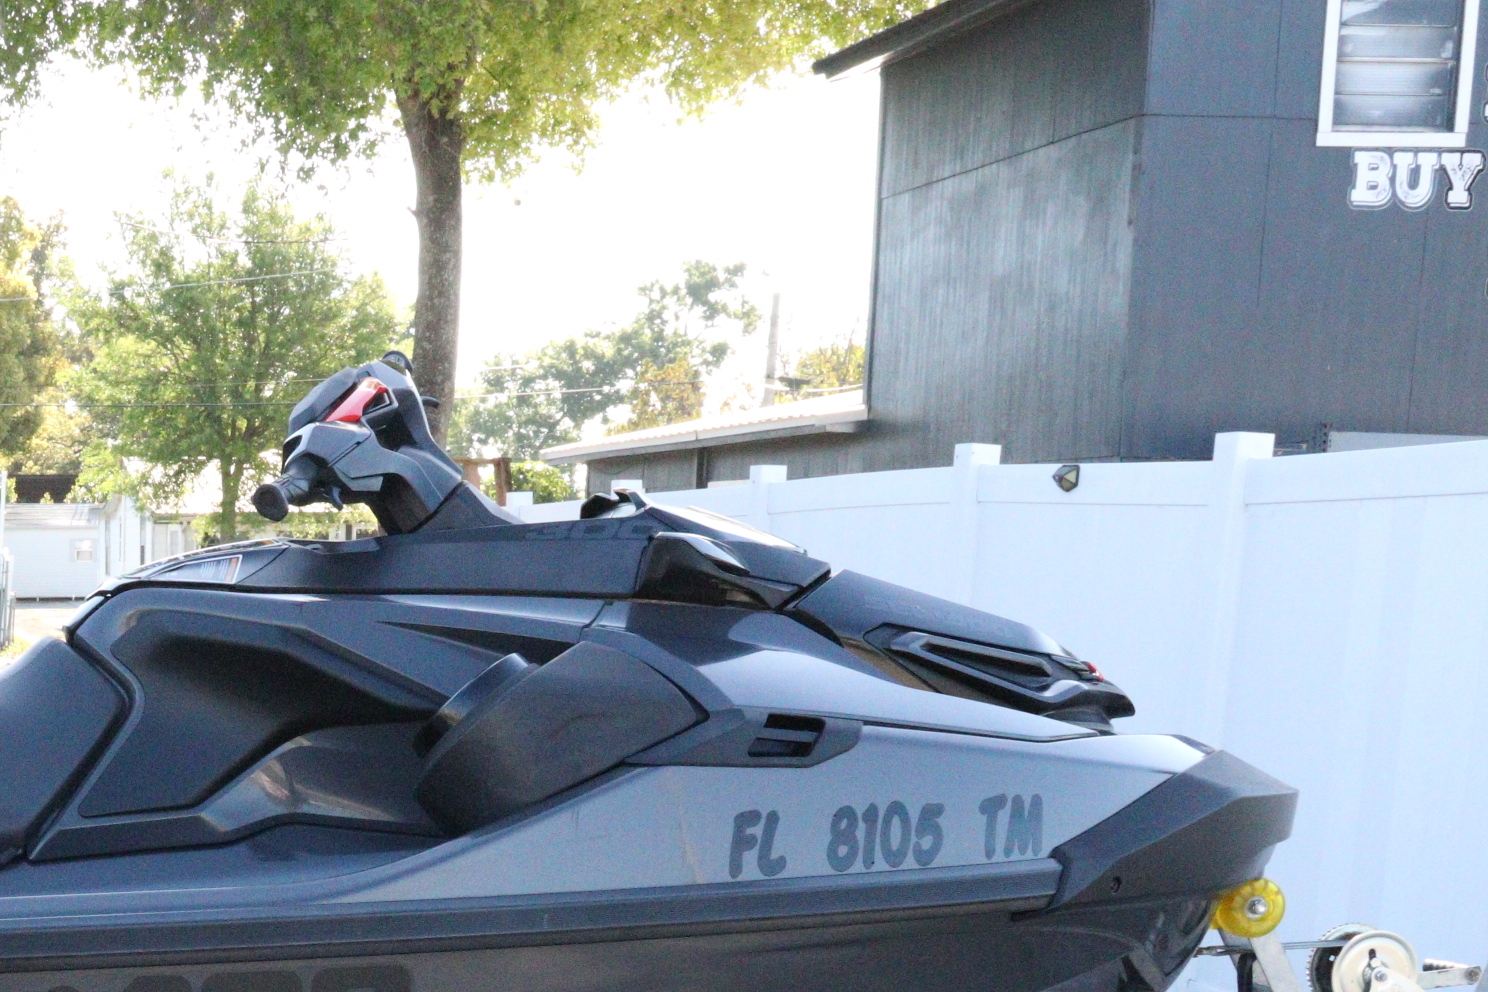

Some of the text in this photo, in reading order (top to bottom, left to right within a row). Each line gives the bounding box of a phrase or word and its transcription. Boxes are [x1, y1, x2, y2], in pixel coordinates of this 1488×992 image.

[1350, 151, 1485, 208] BUY
[728, 793, 1043, 879] FL 8105 TM
